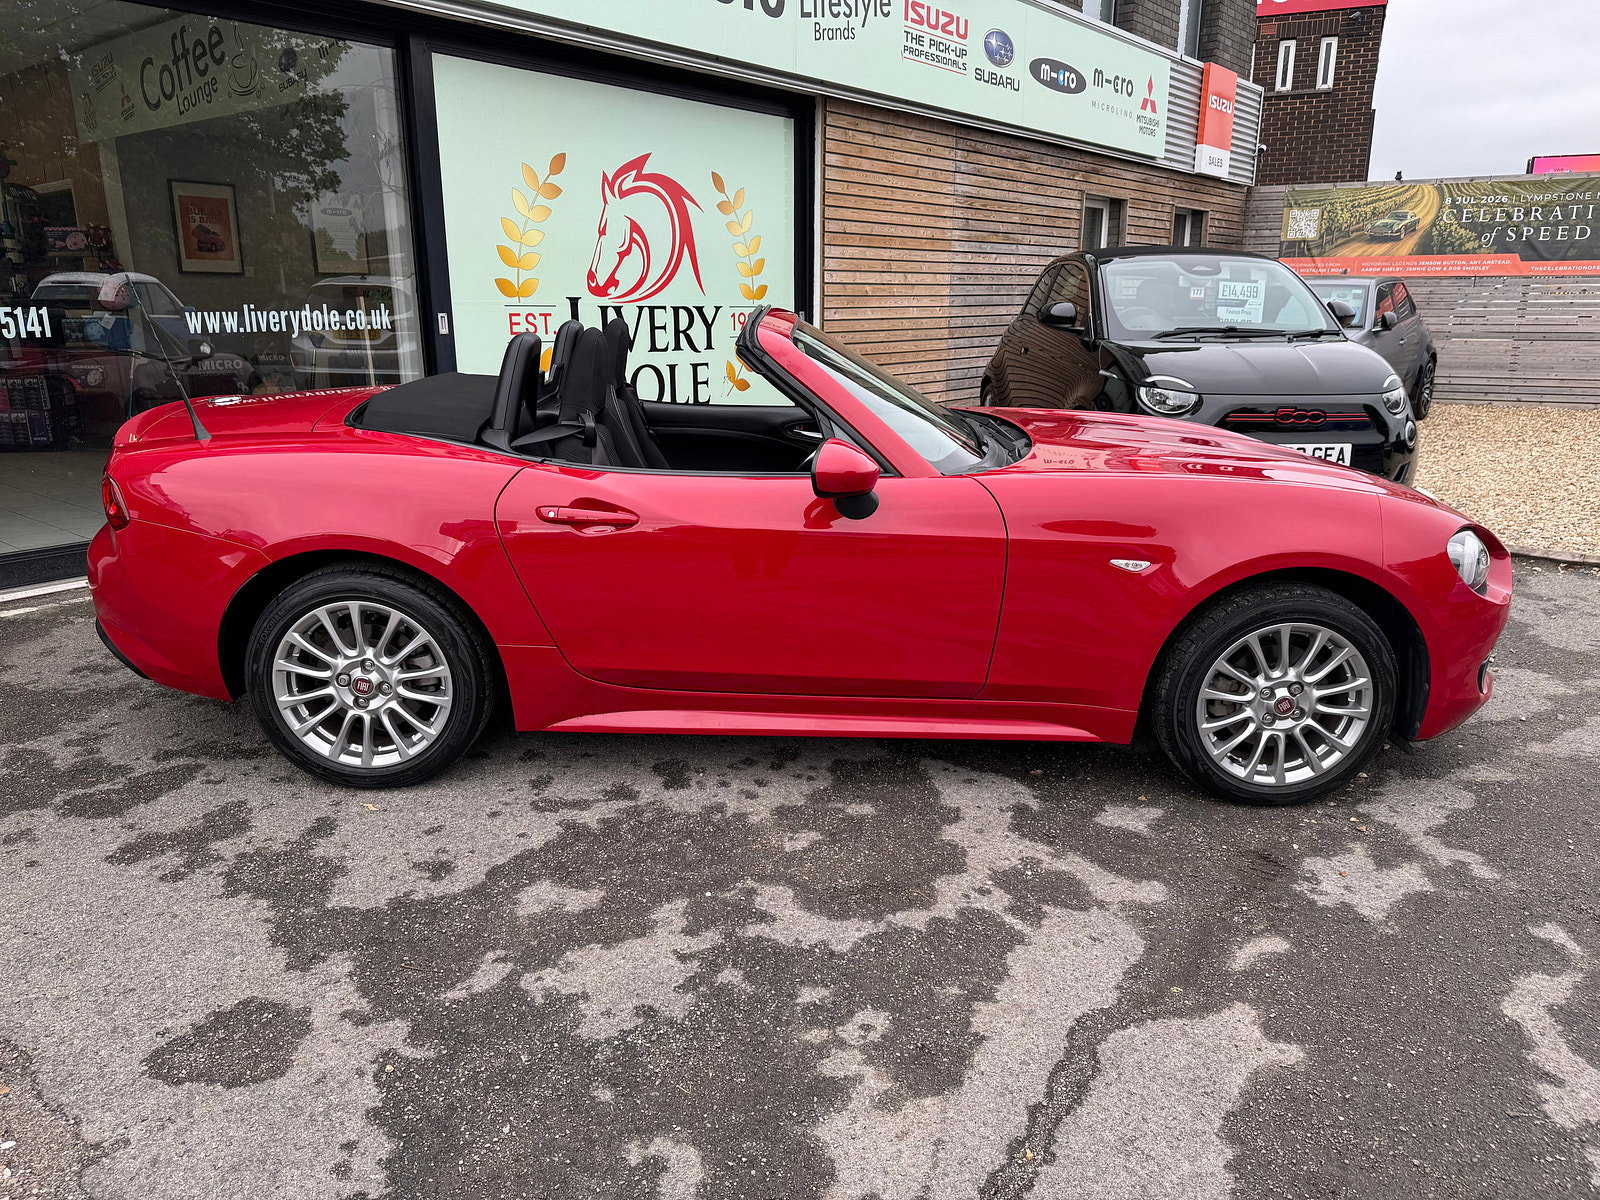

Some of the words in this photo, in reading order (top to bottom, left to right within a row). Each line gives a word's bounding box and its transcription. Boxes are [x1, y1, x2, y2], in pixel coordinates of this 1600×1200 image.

[904, 0, 969, 40] ISUZU
[814, 21, 856, 41] Brands
[904, 31, 925, 47] THE
[928, 39, 968, 59] PICK-UP
[140, 24, 225, 111] Coffee
[903, 45, 967, 71] PROFESSIONALS
[974, 67, 1020, 92] SUBARU
[176, 76, 218, 116] Lounge
[1208, 94, 1233, 115] ISUZU
[1091, 100, 1133, 119] MICROLINO
[1136, 114, 1160, 128] MITSUBISHI
[1138, 126, 1156, 137] MOTORS
[1208, 155, 1223, 168] SALES
[1456, 196, 1477, 204] JUL
[1481, 195, 1508, 203] 2026
[1520, 192, 1592, 202] LYMPSTONE
[1481, 226, 1502, 248] of
[1506, 226, 1592, 242] SPEED
[1222, 284, 1258, 298] £14,499
[0, 306, 52, 338] 5141
[185, 302, 392, 338] www.liverydole.co.uk
[508, 312, 557, 337] EST.
[198, 360, 244, 370] MICRO
[1276, 408, 1325, 424] 500
[357, 680, 371, 692] FIAT
[1278, 700, 1290, 712] FIAT
